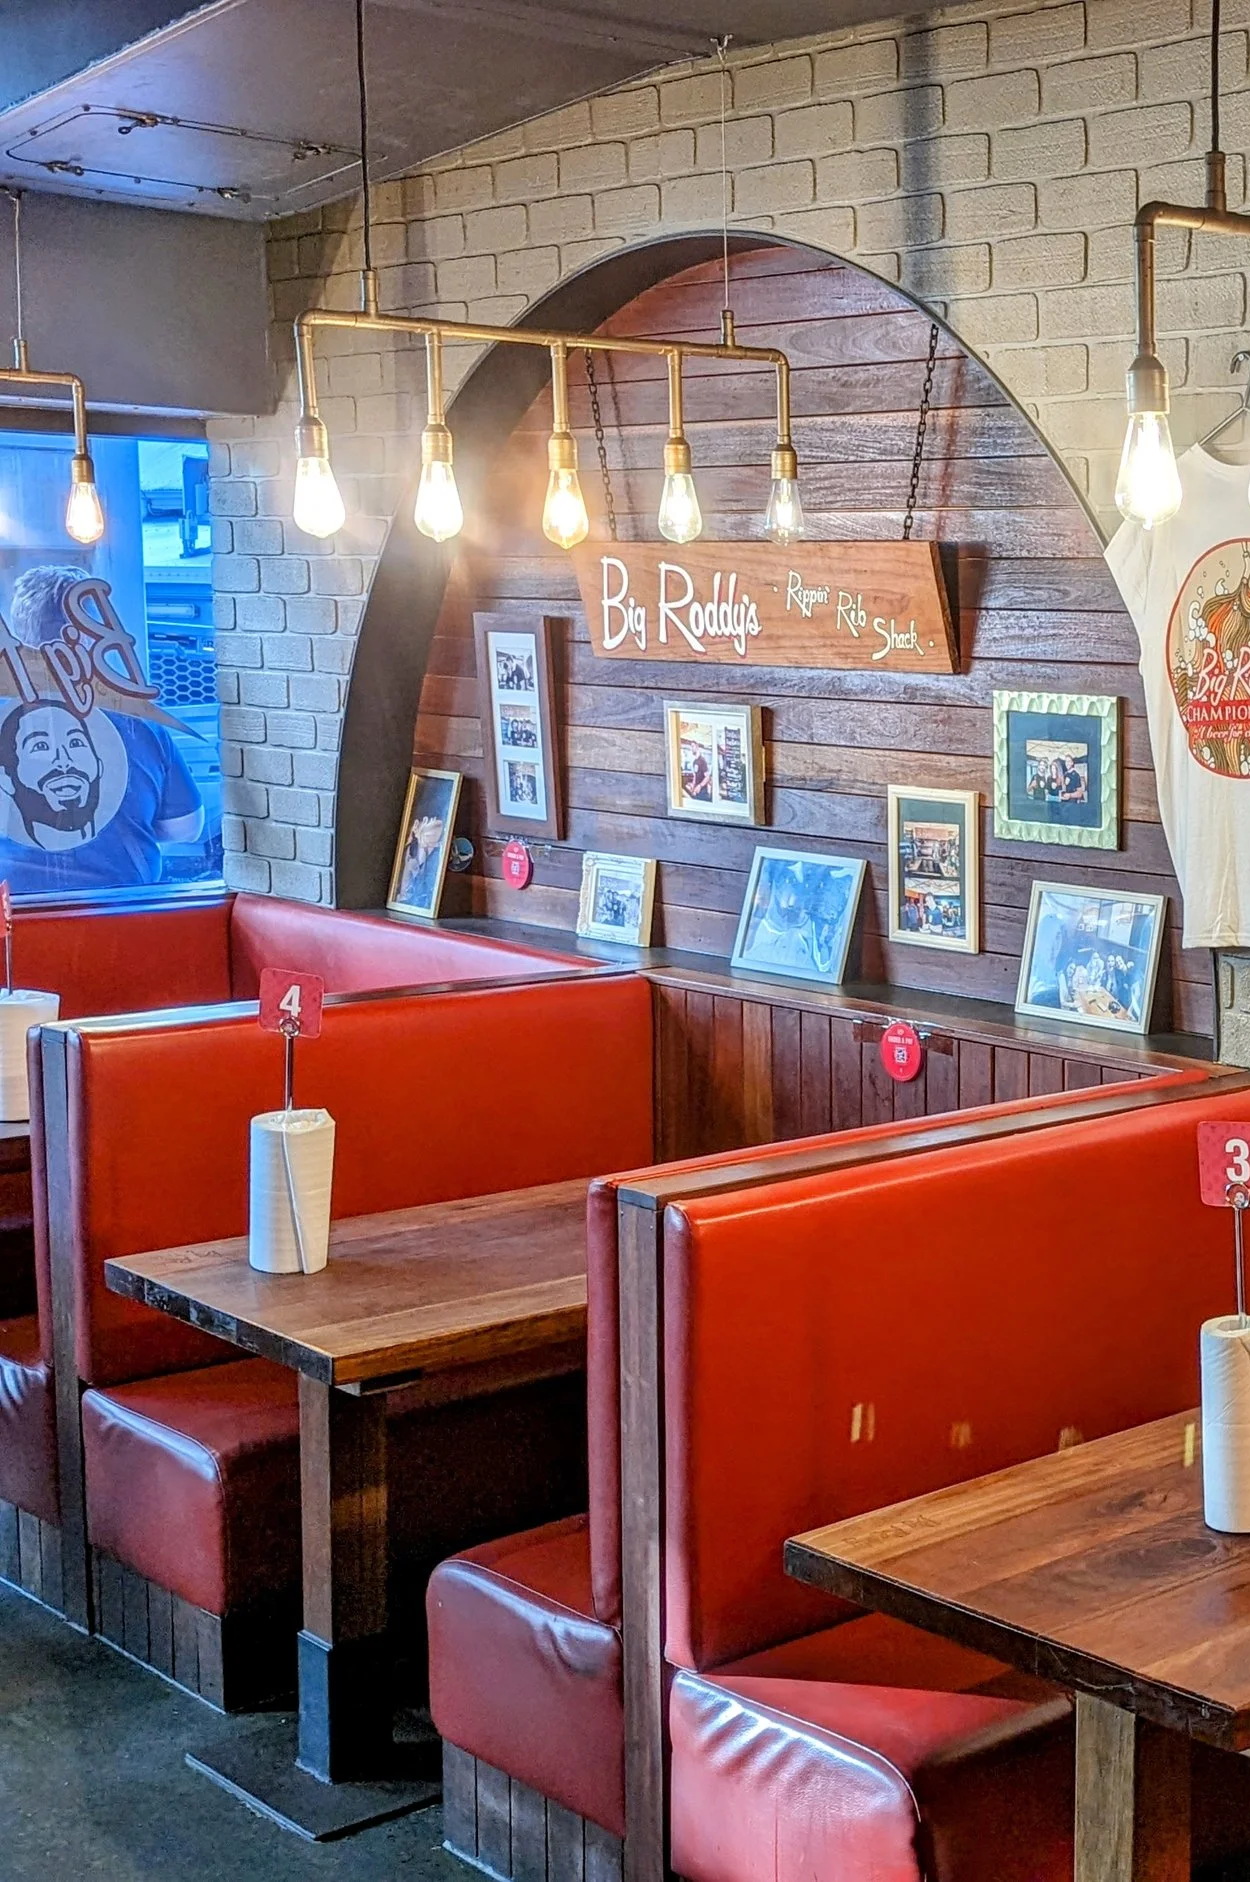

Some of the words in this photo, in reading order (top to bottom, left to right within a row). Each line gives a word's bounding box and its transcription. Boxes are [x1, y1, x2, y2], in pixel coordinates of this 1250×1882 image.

[601, 555, 647, 652] Big
[657, 561, 763, 657] Roddy's
[836, 590, 868, 638] Rib
[1194, 646, 1228, 706] Big
[279, 984, 302, 1018] 4
[1224, 1138, 1250, 1183] 3
